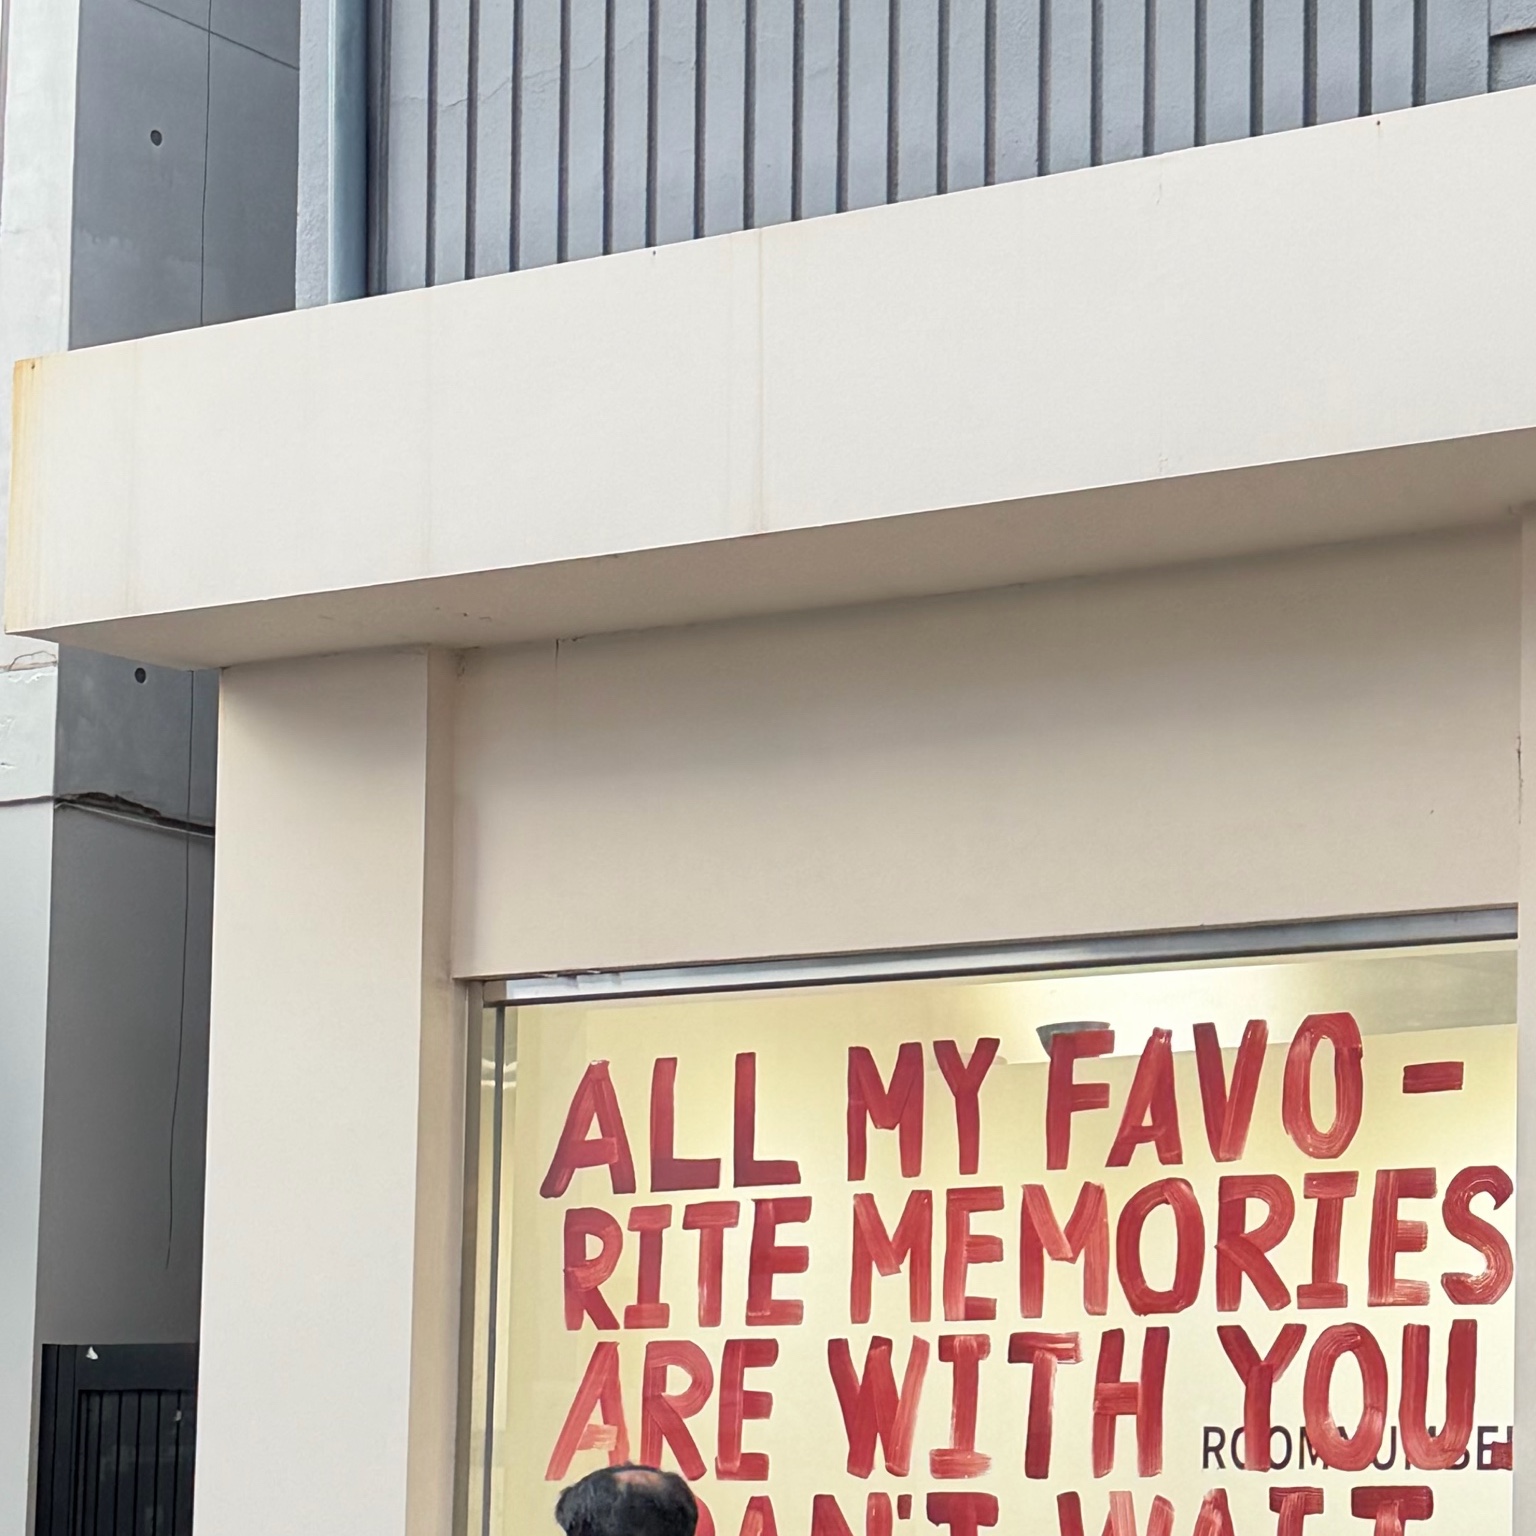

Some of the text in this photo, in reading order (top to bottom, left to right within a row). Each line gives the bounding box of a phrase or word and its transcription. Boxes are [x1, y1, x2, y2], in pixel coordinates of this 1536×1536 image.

[539, 1052, 801, 1199] ALL
[847, 1037, 1000, 1182] MY
[563, 1165, 1513, 1330] RITE MEMORIES
[545, 1338, 779, 1481] ARE
[827, 1327, 1170, 1480] WITH
